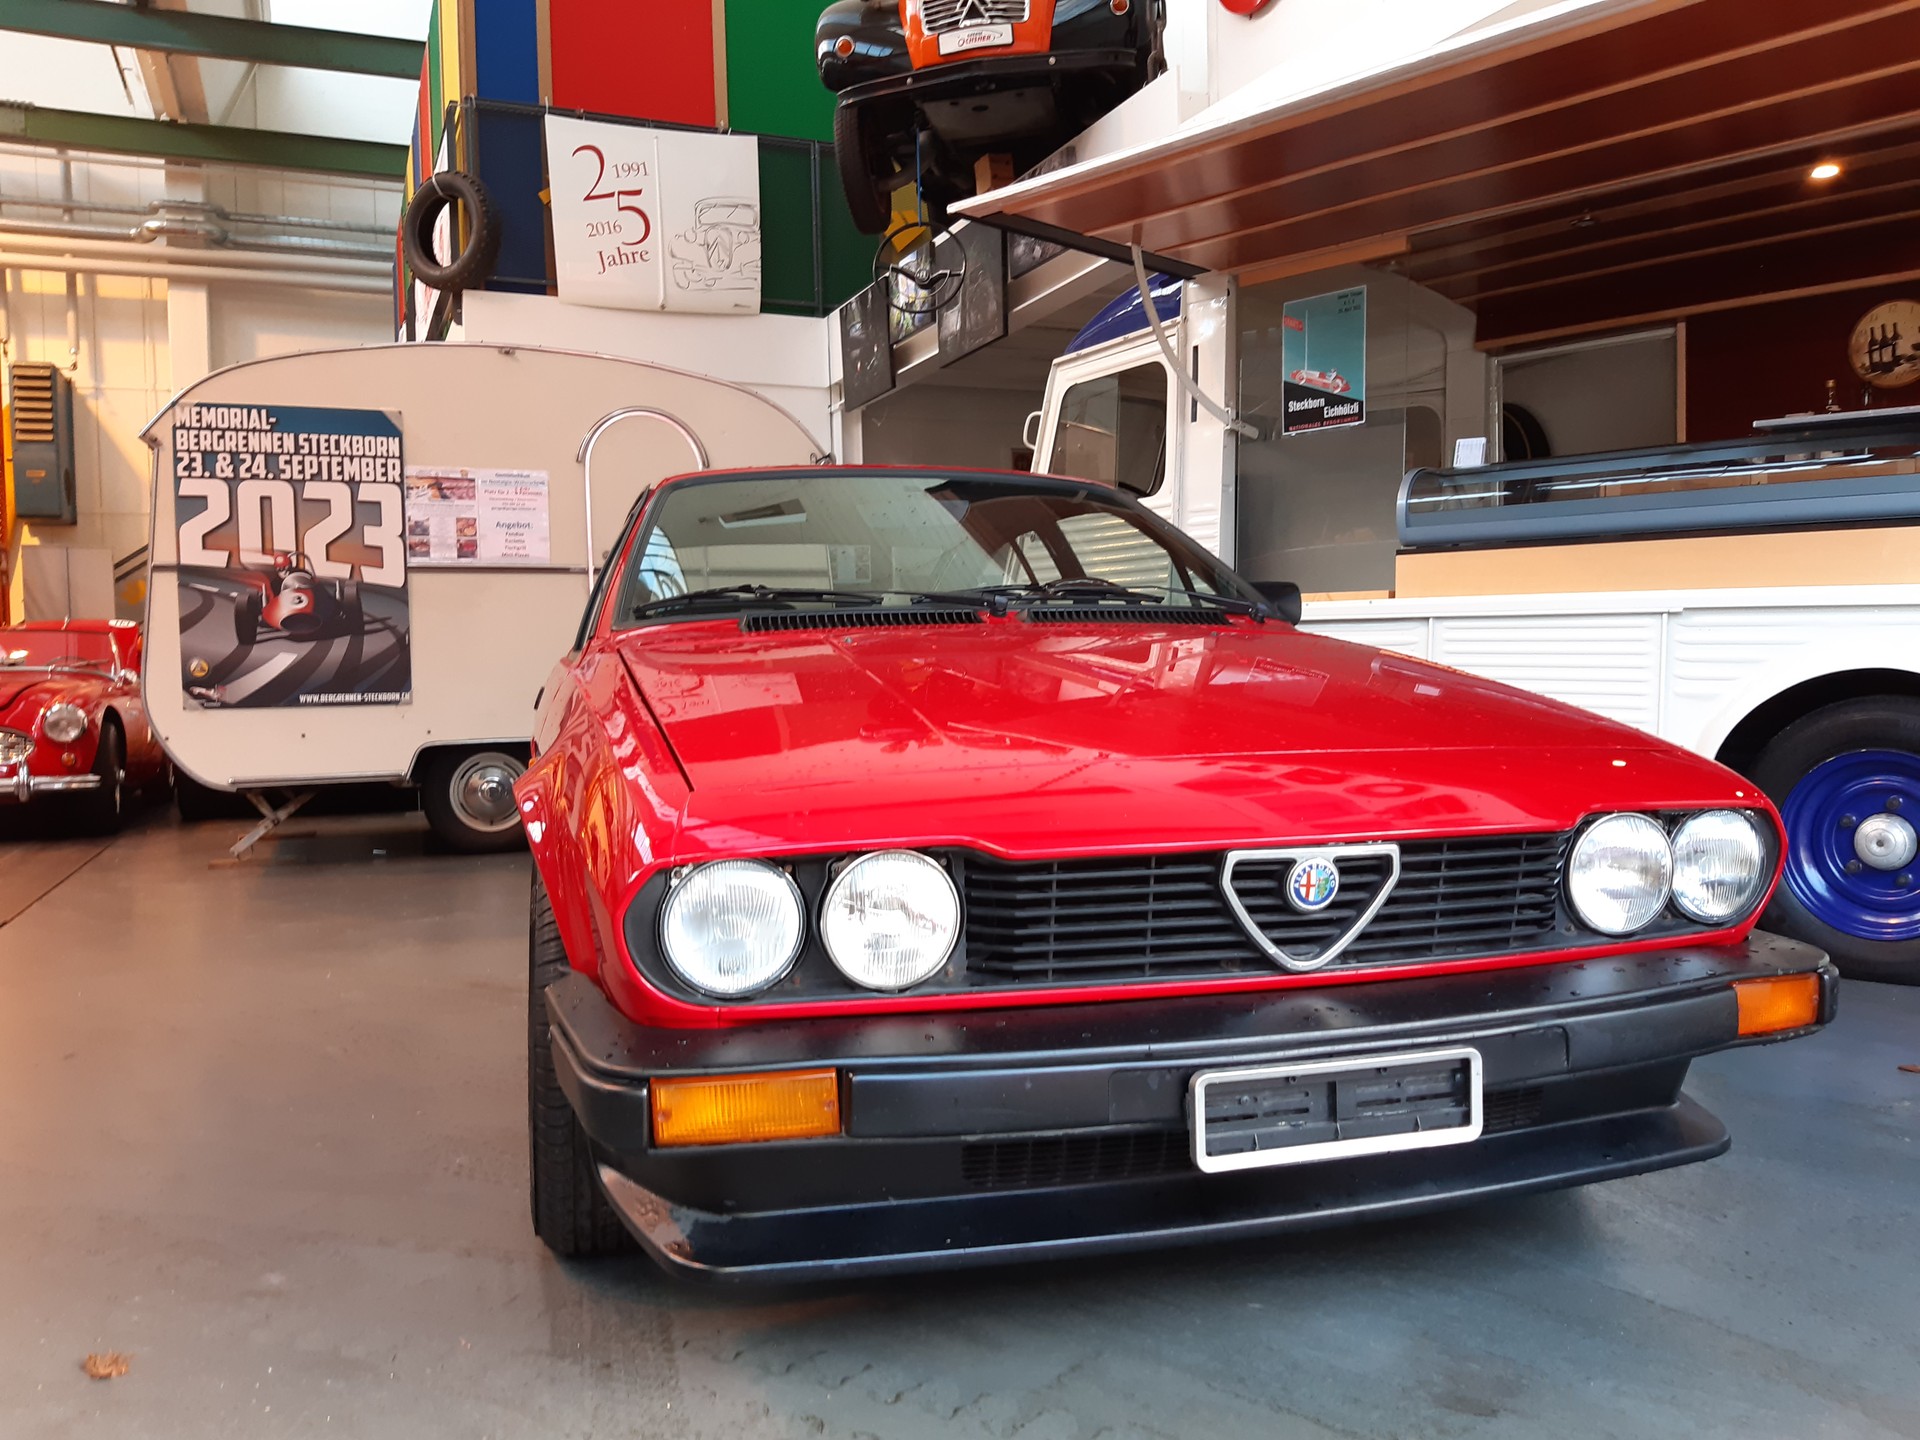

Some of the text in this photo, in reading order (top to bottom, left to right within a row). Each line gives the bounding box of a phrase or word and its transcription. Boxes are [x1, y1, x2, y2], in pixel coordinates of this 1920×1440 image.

[612, 161, 649, 178] 1991
[586, 219, 623, 238] 2016
[597, 247, 651, 274] Jahre
[1288, 397, 1325, 413] Steckborn
[1324, 402, 1360, 419] Eichhölzli
[175, 406, 277, 430] MEMORIAL-
[176, 429, 400, 458] BERGRENNEN STECKBORN
[176, 451, 401, 483] 23. & 24. SEPTEMBER
[178, 477, 405, 588] 2023
